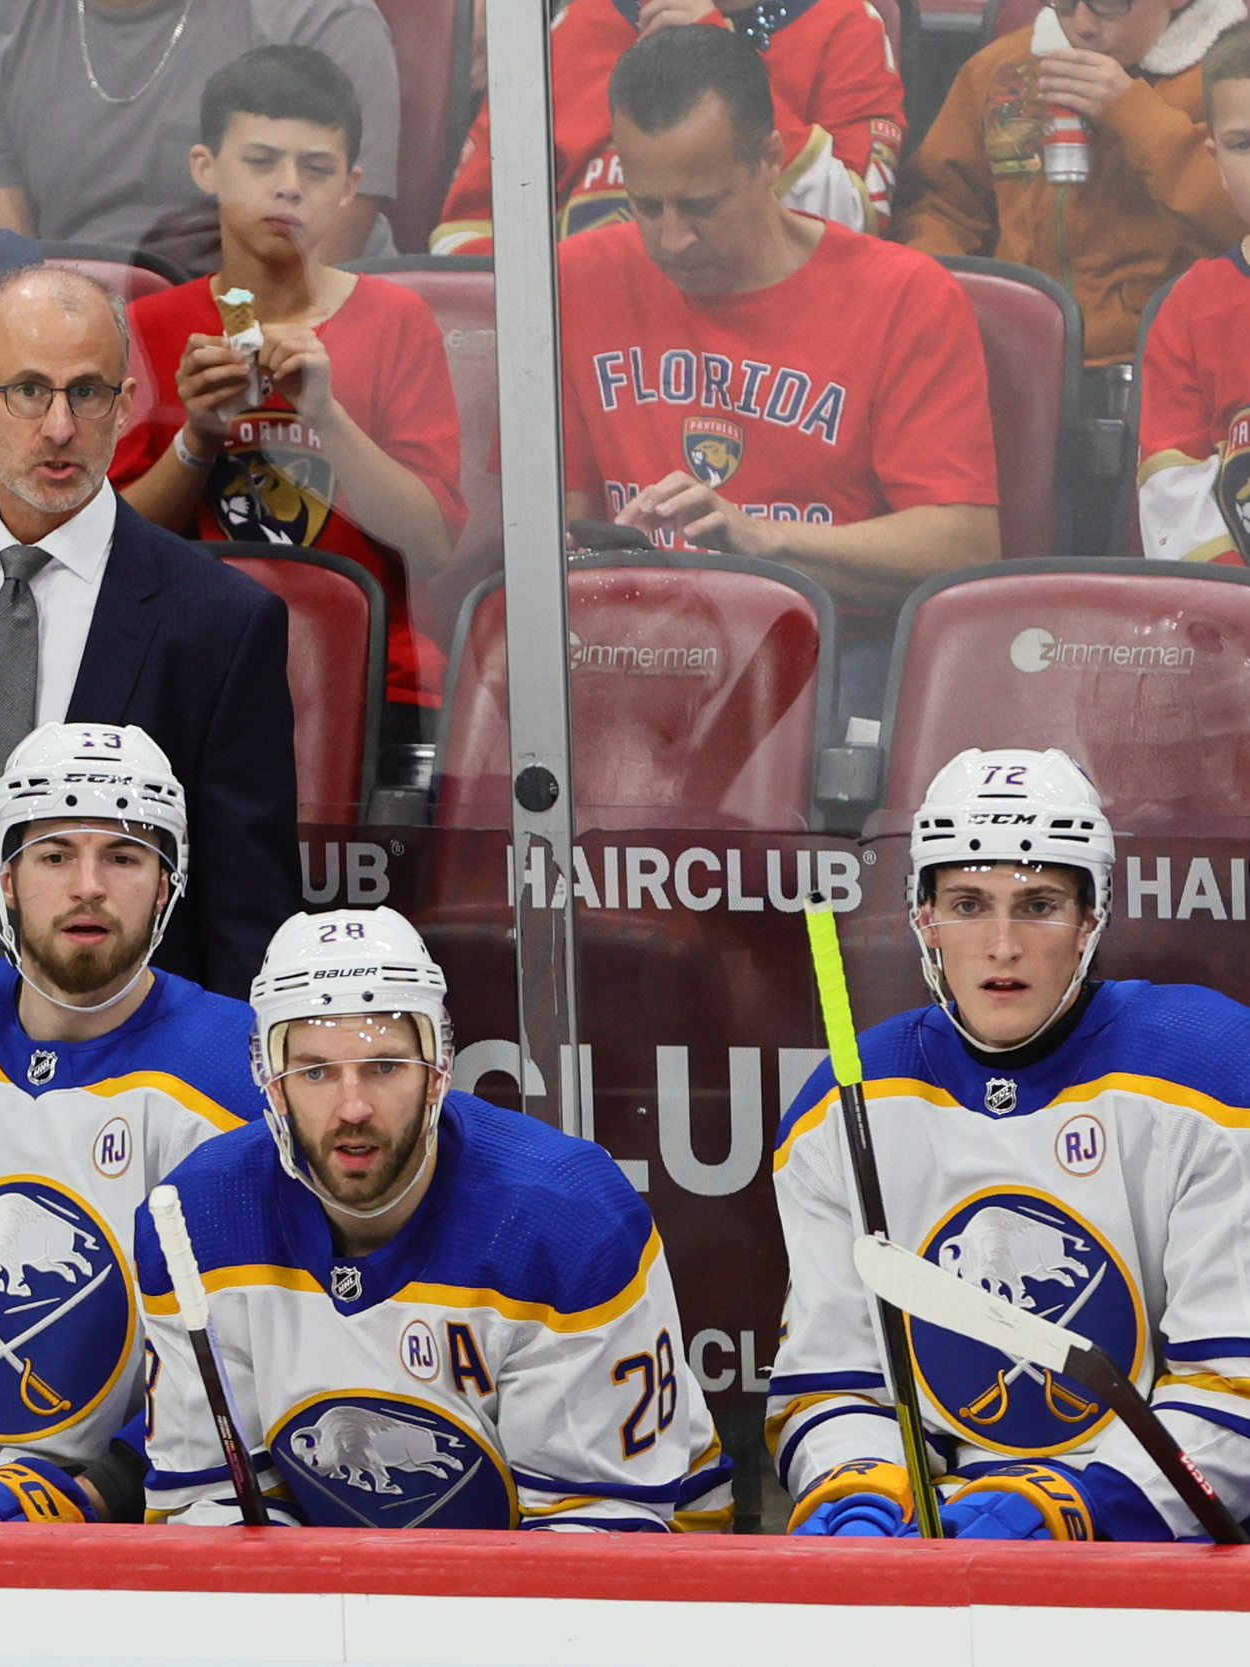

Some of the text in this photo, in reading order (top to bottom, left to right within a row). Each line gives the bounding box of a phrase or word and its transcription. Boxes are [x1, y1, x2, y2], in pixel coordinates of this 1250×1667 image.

[593, 346, 847, 447] FLORIDA
[689, 419, 740, 439] PANTHERS
[1039, 637, 1195, 667] zimmerman
[81, 732, 122, 749] 13
[981, 765, 1027, 786] 72
[968, 814, 1038, 825] CCM
[318, 922, 365, 943] 28
[313, 967, 379, 980] BAUER
[100, 1129, 126, 1166] RJ
[1065, 1127, 1098, 1165] RJ
[407, 1320, 497, 1398] RJ A
[610, 1326, 678, 1462] 28
